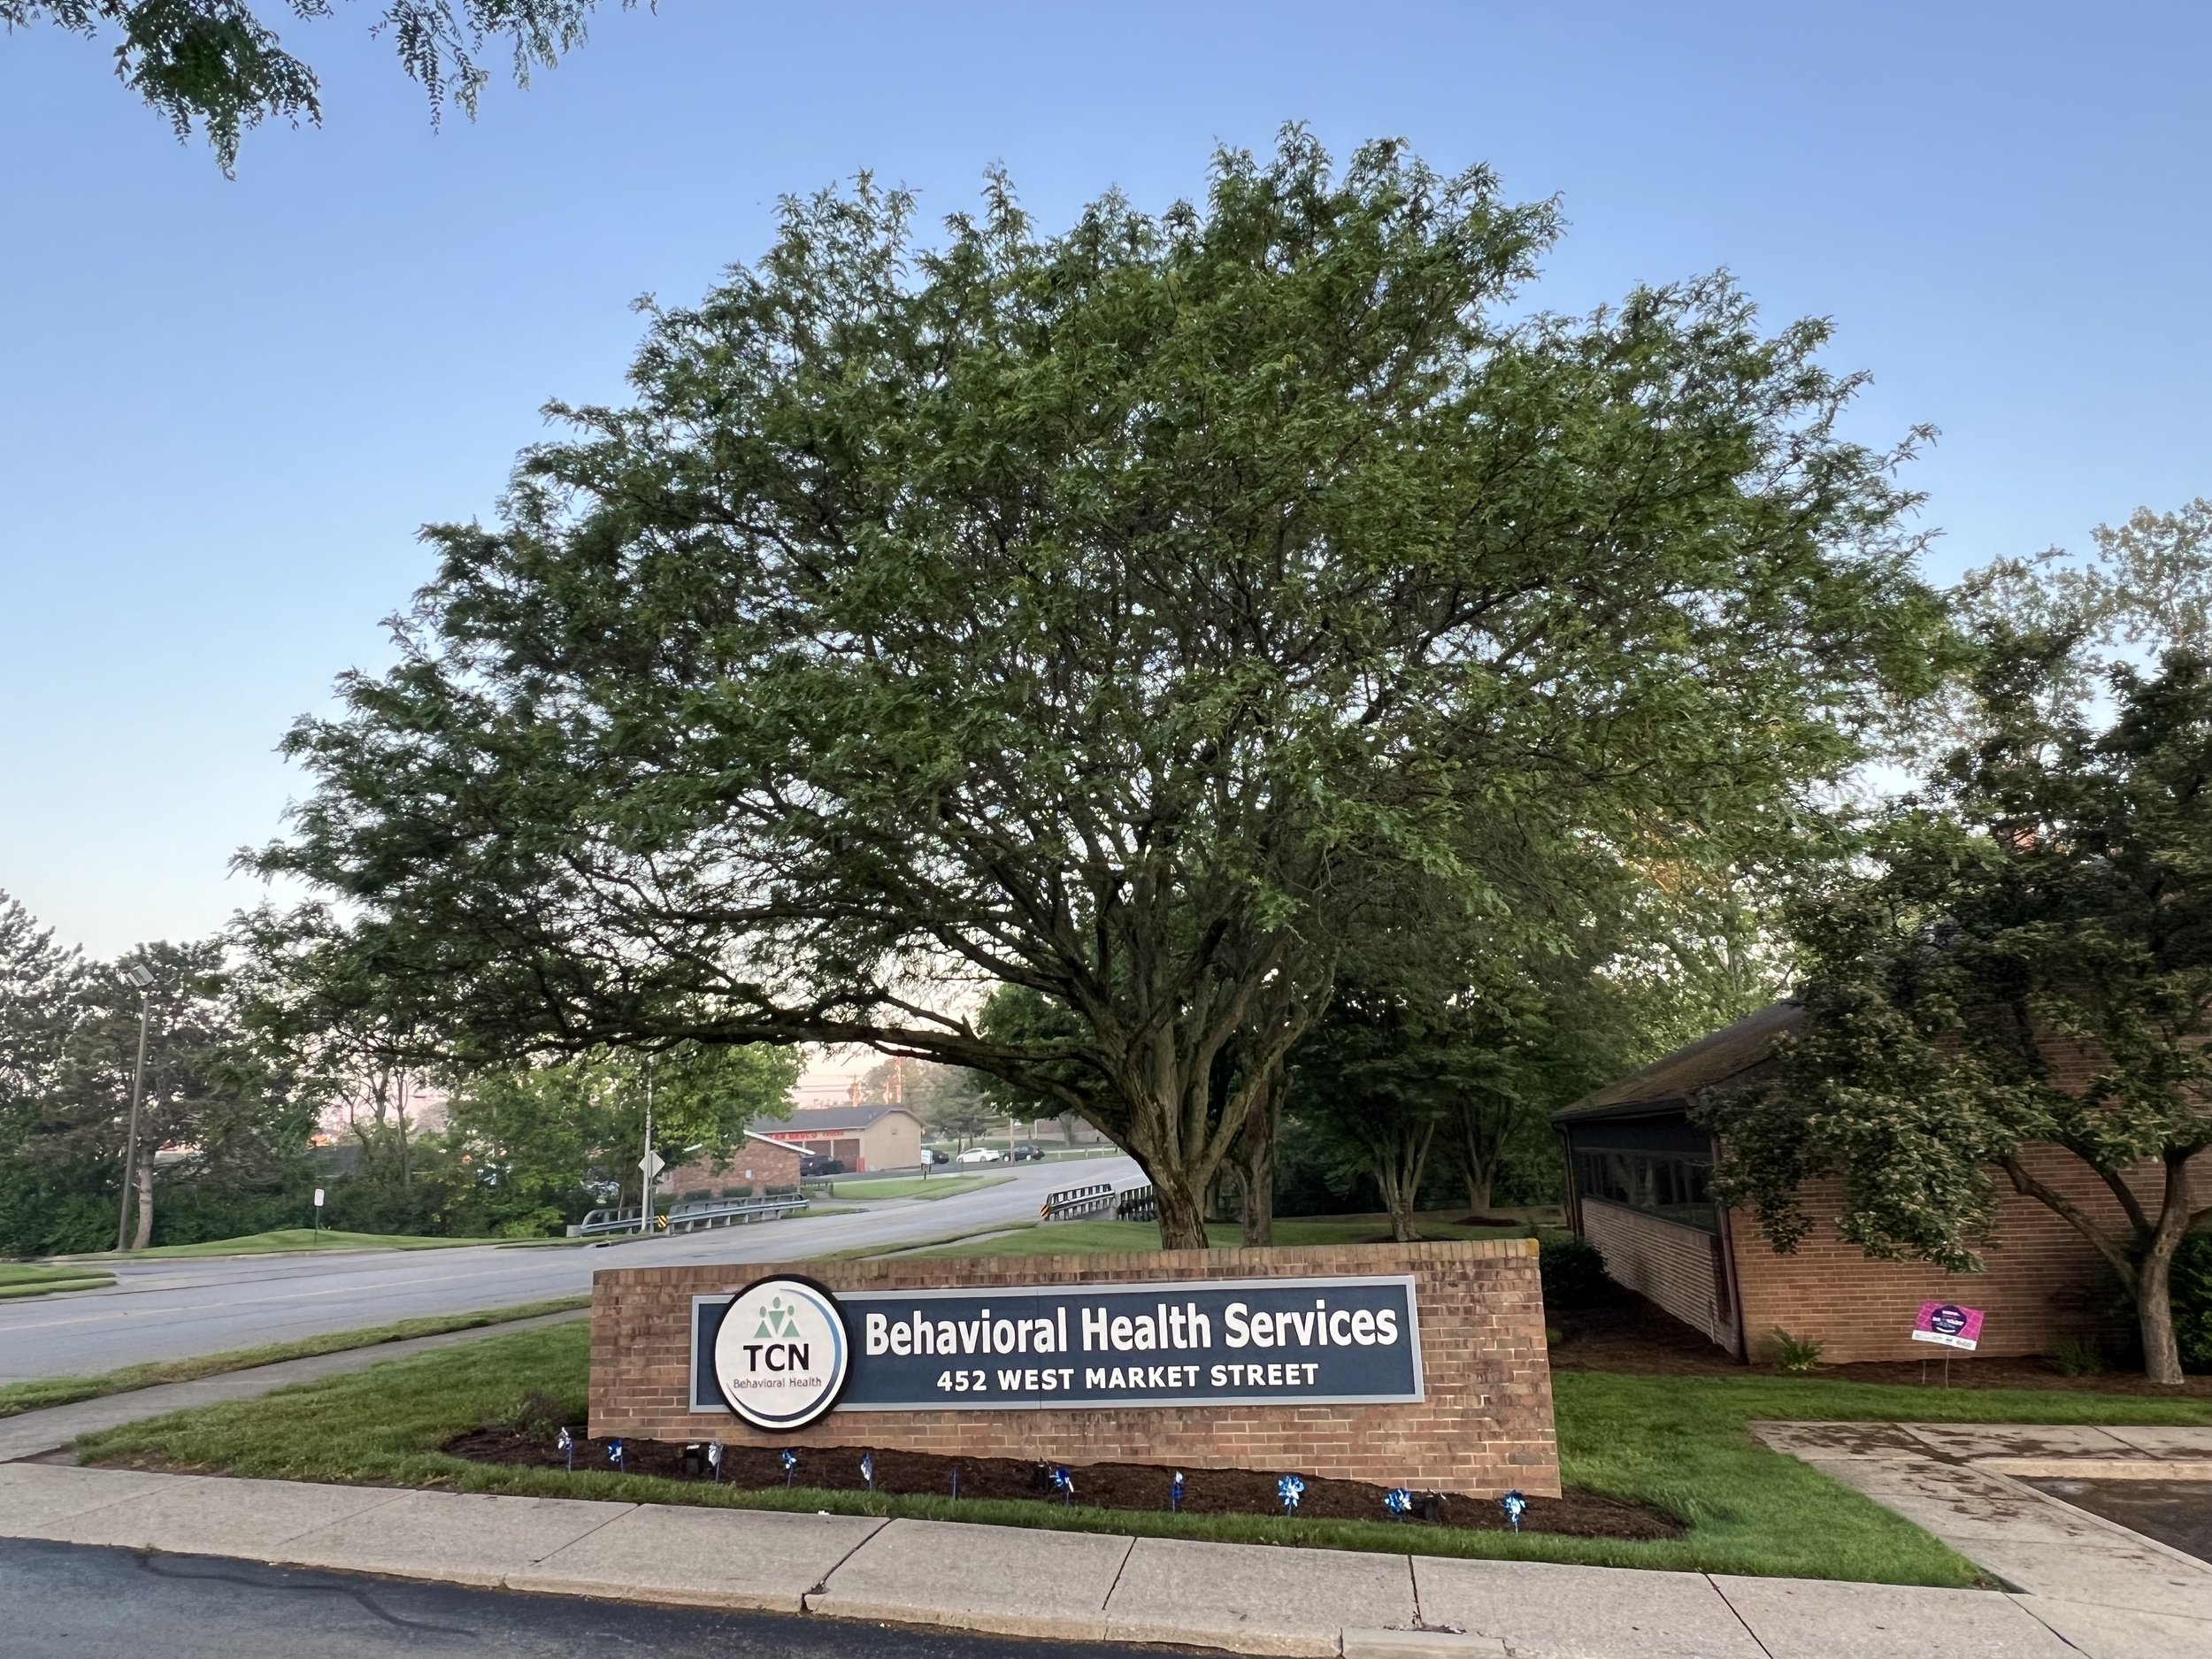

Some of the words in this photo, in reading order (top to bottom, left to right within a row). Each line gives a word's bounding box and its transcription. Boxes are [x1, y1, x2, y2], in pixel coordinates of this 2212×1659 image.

[865, 1307, 1067, 1356] Behavioral
[1081, 1302, 1212, 1352] Health
[1225, 1299, 1399, 1348] Services
[743, 1343, 810, 1371] TCN
[733, 1378, 786, 1389] Behavioral
[788, 1377, 822, 1387] Health
[937, 1371, 987, 1392] 452
[997, 1368, 1074, 1391] WEST
[1086, 1365, 1200, 1389] MARKET
[1210, 1363, 1318, 1387] STREET
